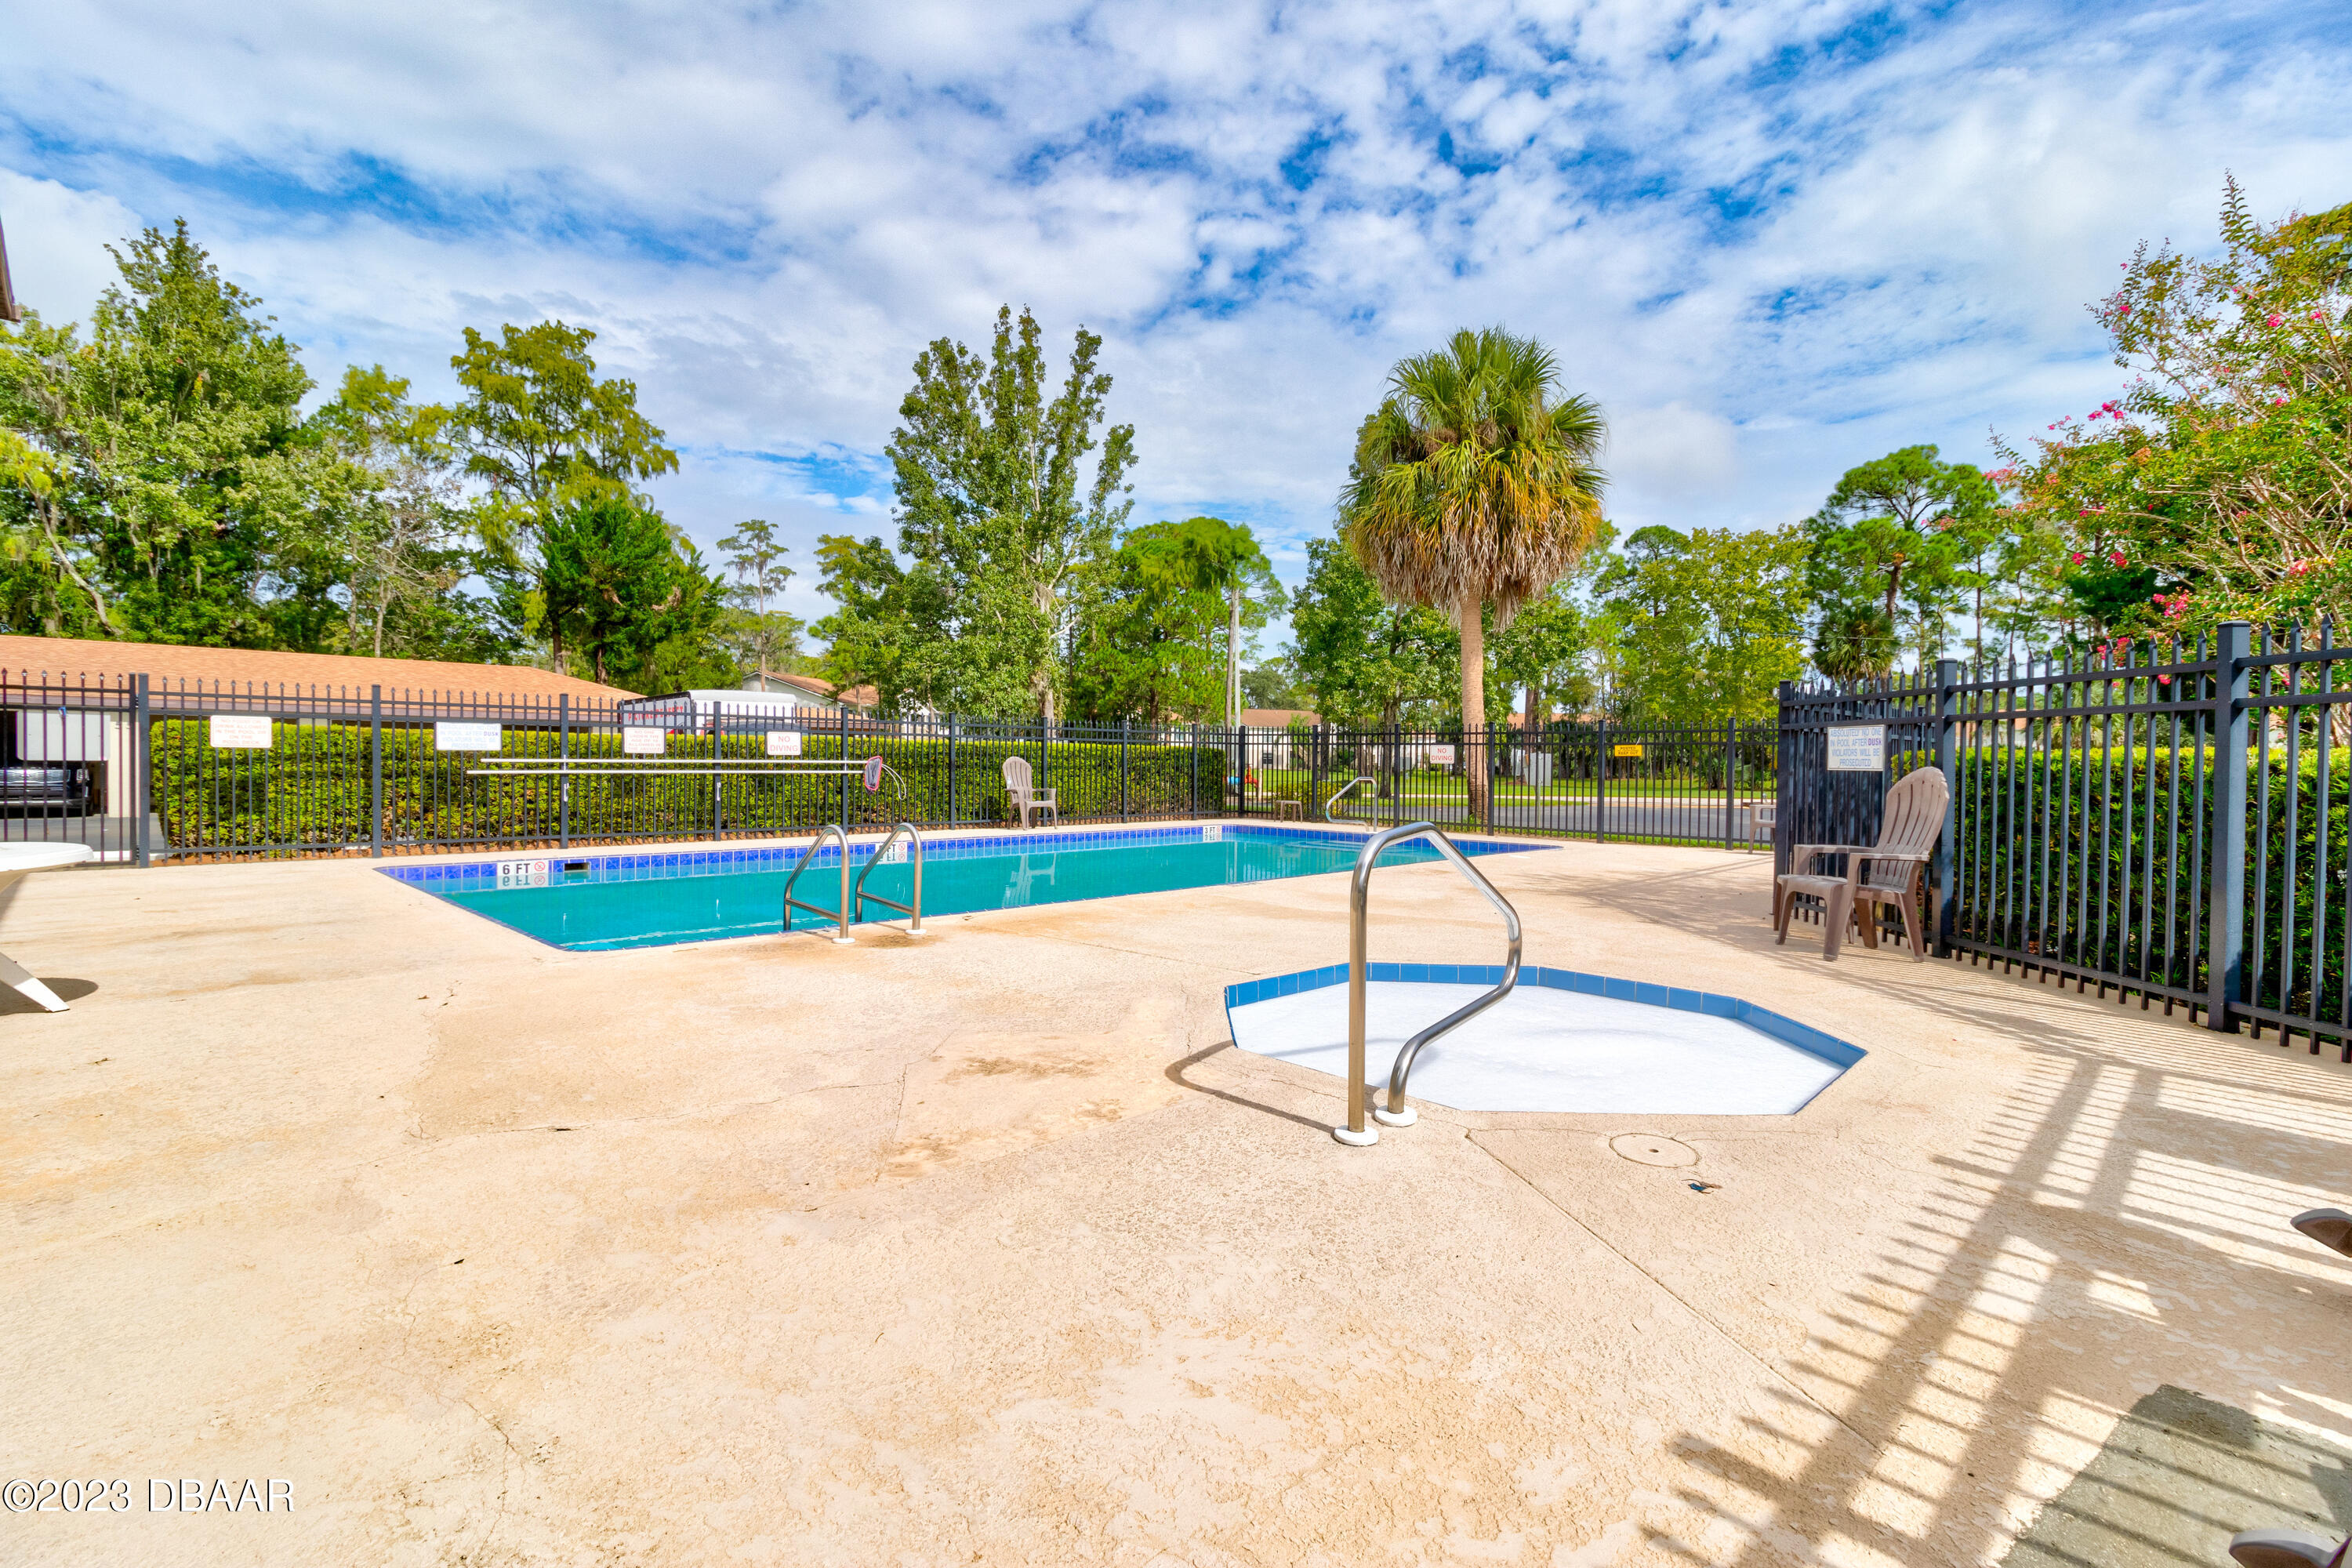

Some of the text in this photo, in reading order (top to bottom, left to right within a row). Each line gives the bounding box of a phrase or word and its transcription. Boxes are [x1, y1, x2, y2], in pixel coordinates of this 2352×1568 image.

[1861, 728, 1869, 736] NO
[1871, 728, 1882, 736] ONE
[1837, 739, 1850, 747] POOL
[1852, 738, 1867, 746] AFTER
[1831, 748, 1880, 757] VIOLATORS WILL BE
[1839, 758, 1871, 767] PROSECUTED
[503, 863, 531, 875] 6 FT
